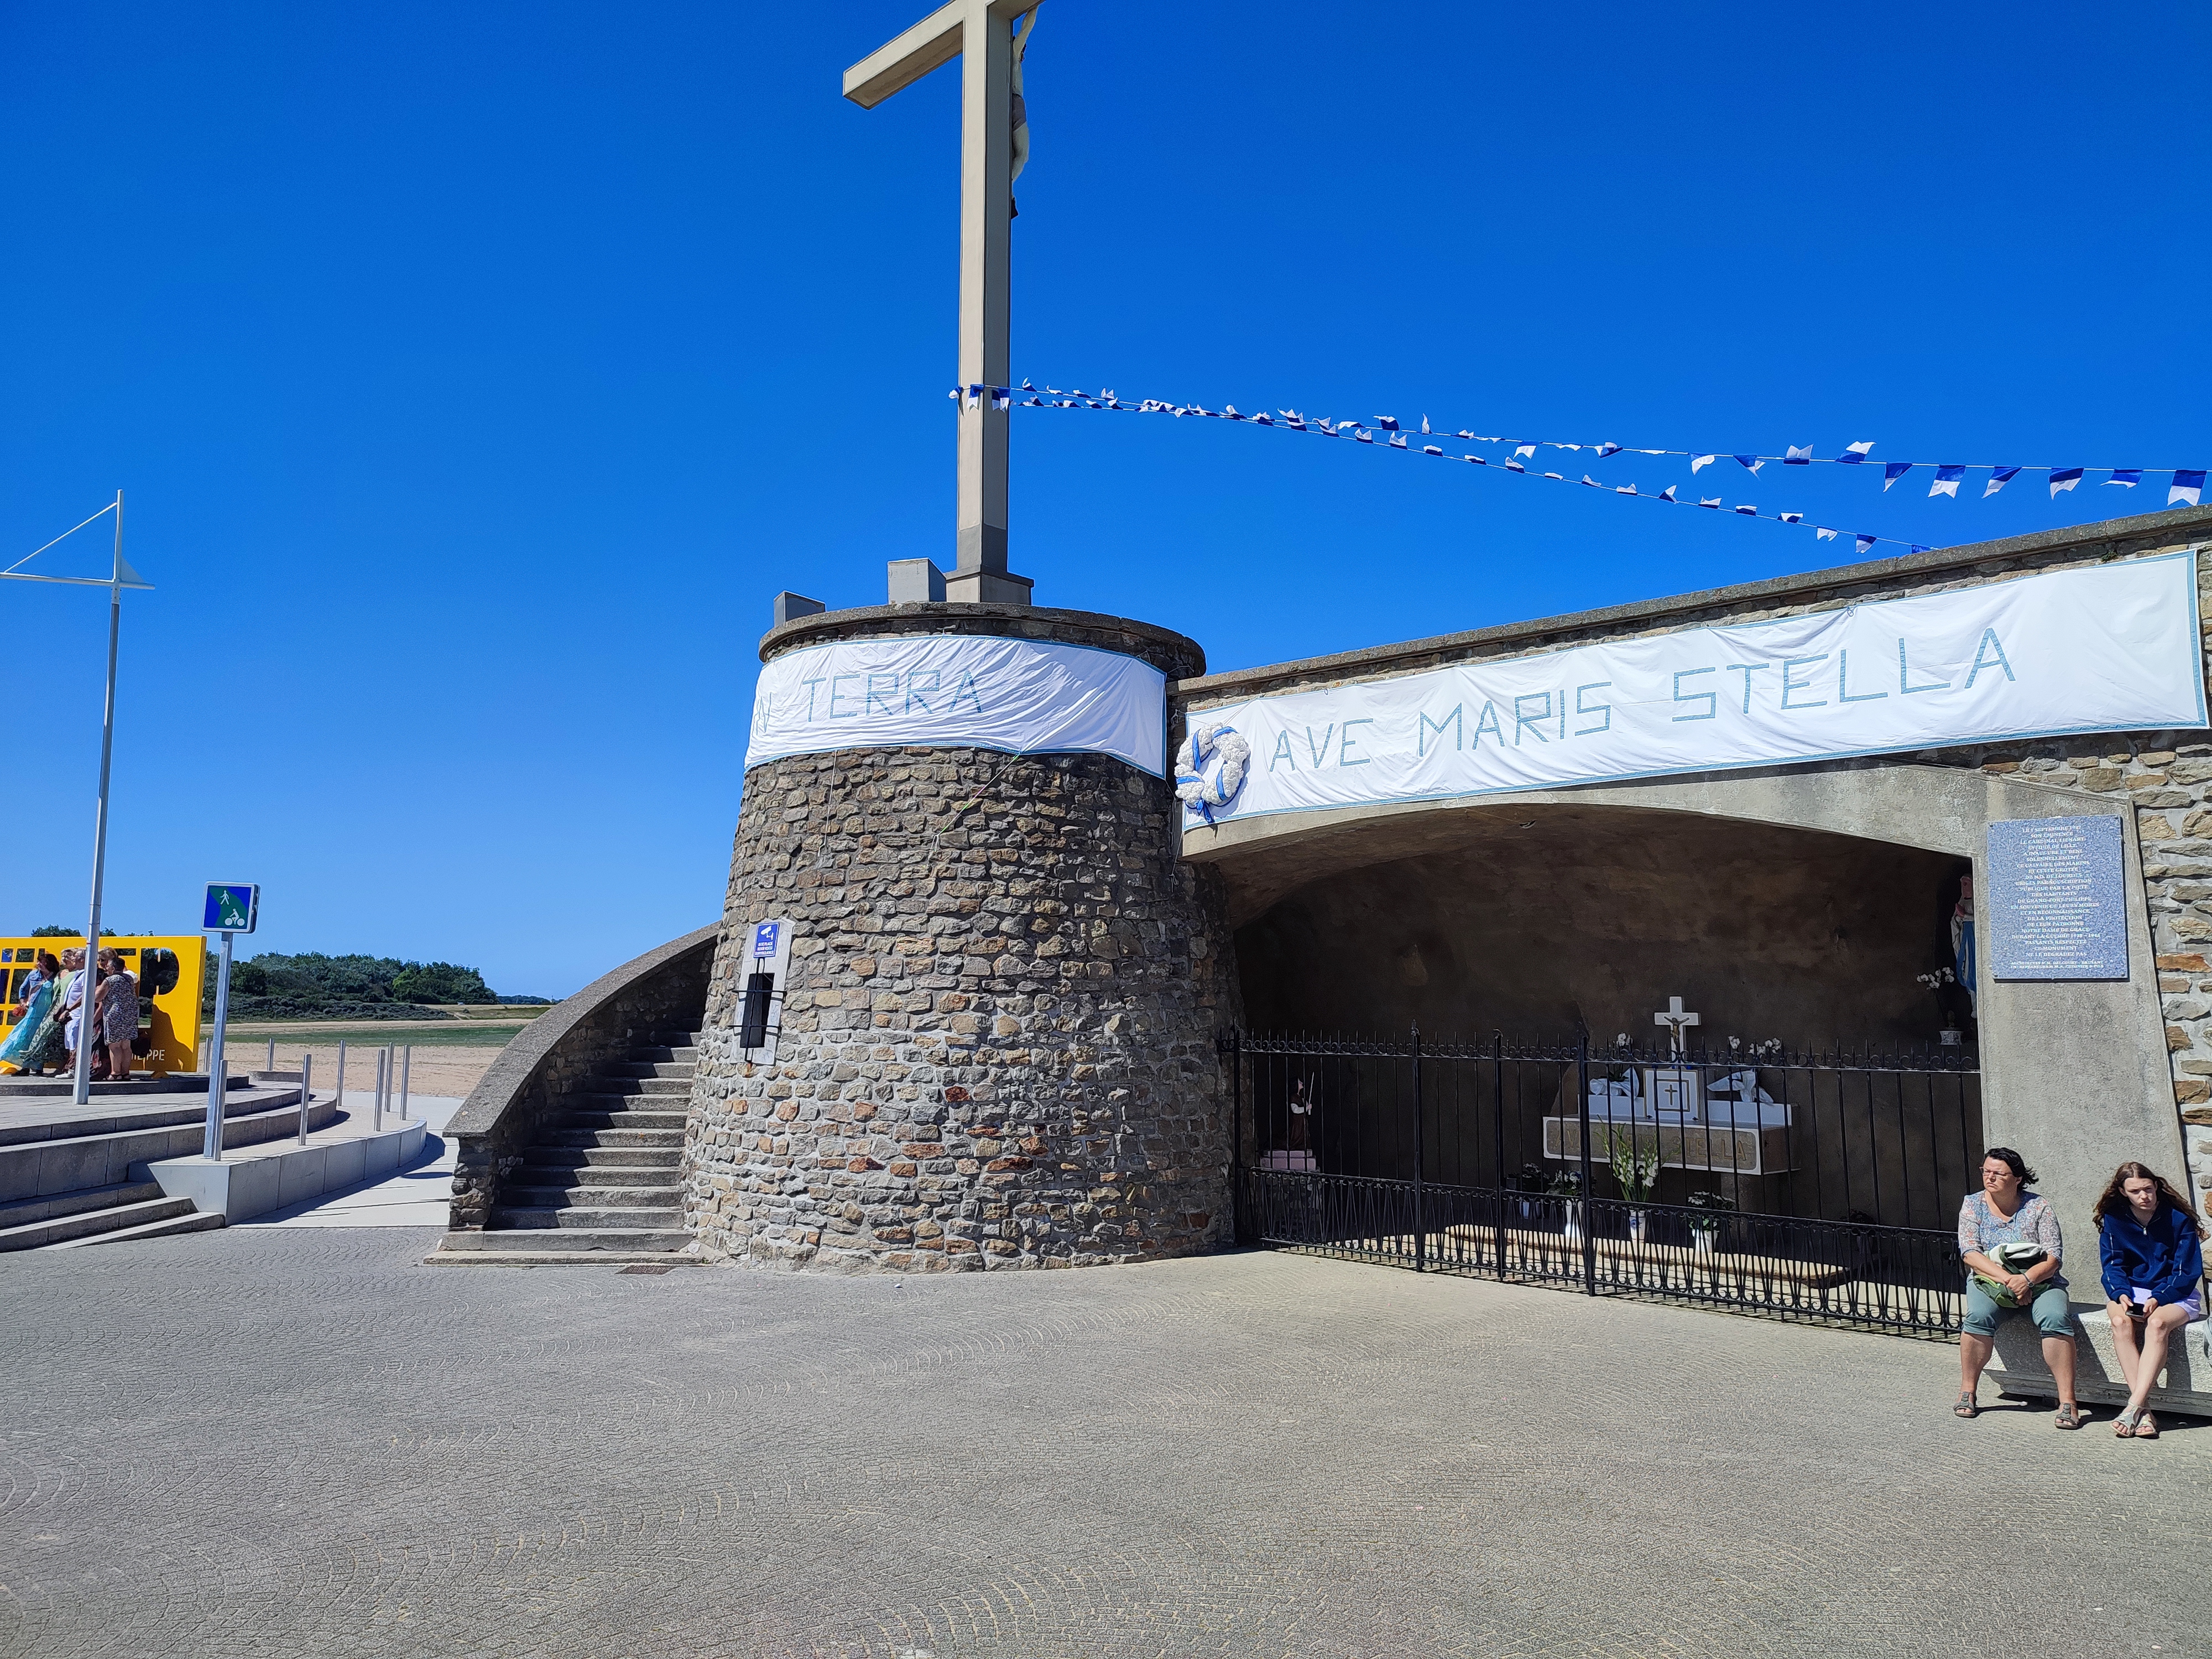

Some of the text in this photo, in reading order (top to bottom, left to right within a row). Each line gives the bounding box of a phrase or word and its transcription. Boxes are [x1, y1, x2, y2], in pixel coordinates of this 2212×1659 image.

[802, 669, 983, 722] TERRA
[1269, 627, 2016, 773] AVE MARIS STELLA
